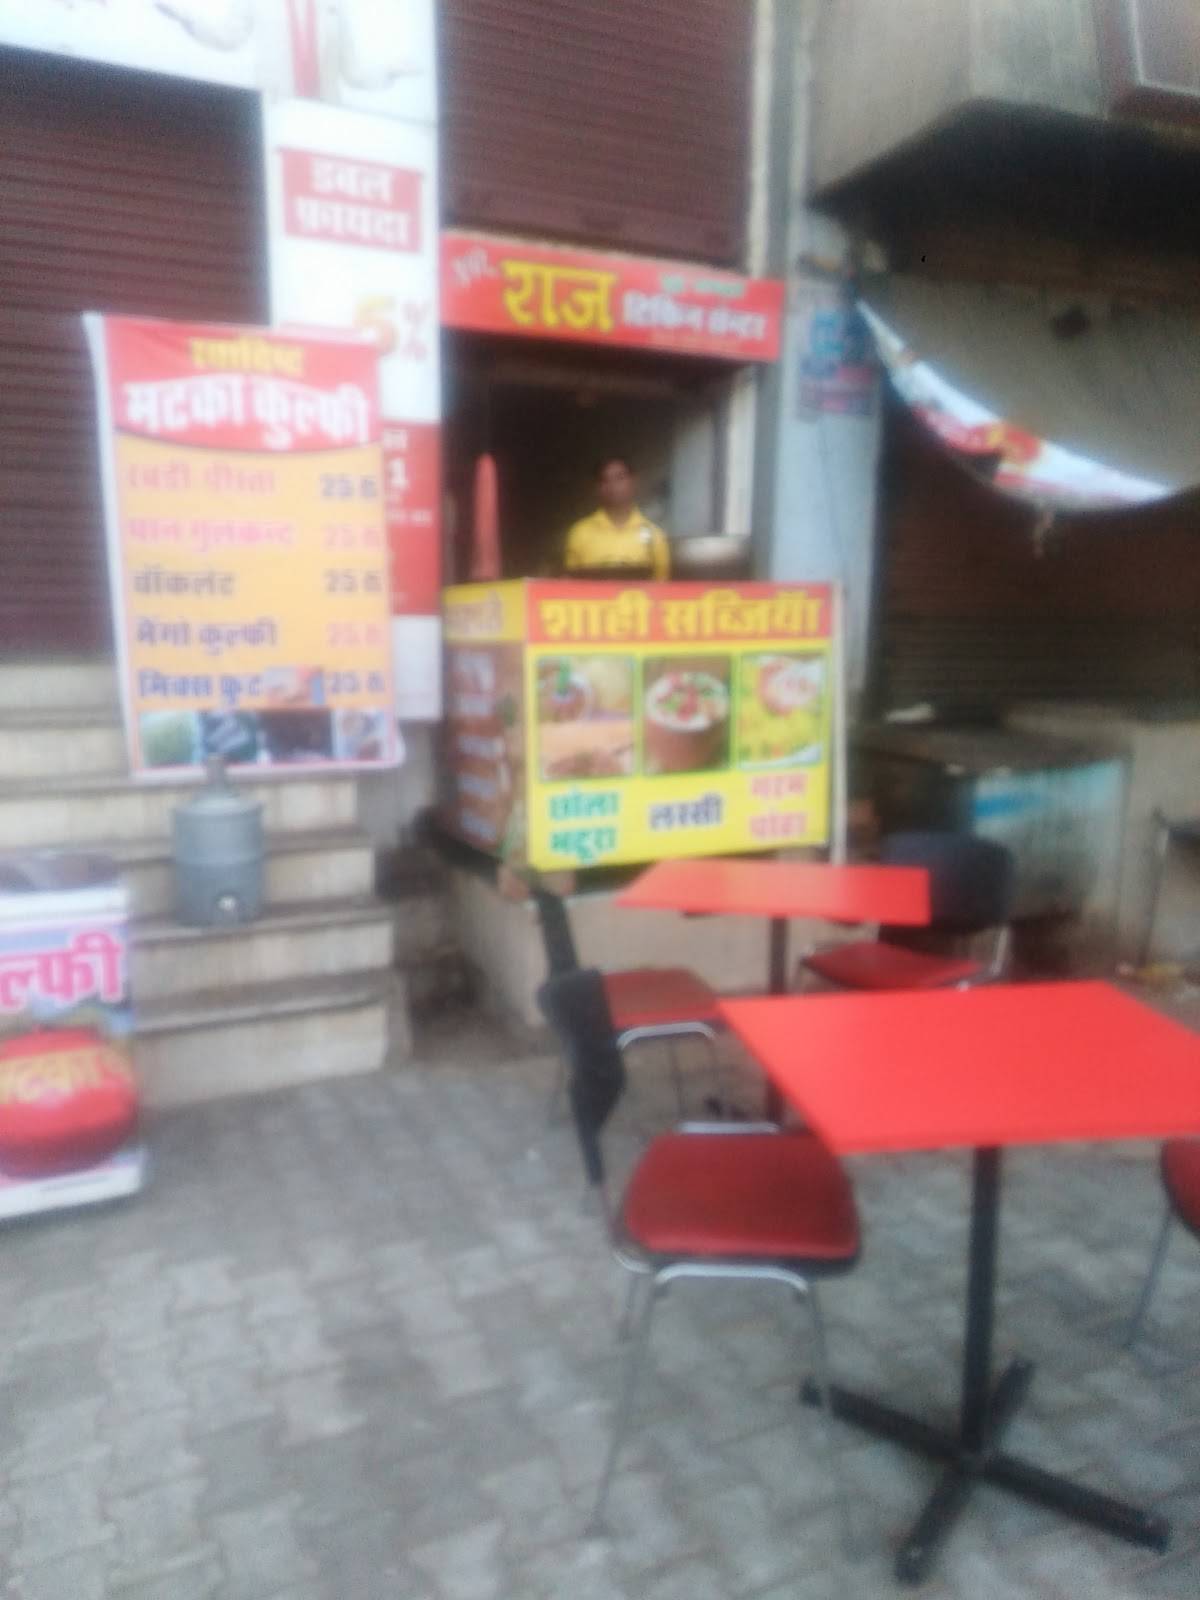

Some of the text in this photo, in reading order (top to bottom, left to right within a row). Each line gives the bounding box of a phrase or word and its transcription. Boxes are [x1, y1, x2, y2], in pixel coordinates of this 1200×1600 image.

[501, 259, 618, 333] राज
[124, 373, 371, 451] मटका कुल्फी
[540, 589, 651, 639] शाही
